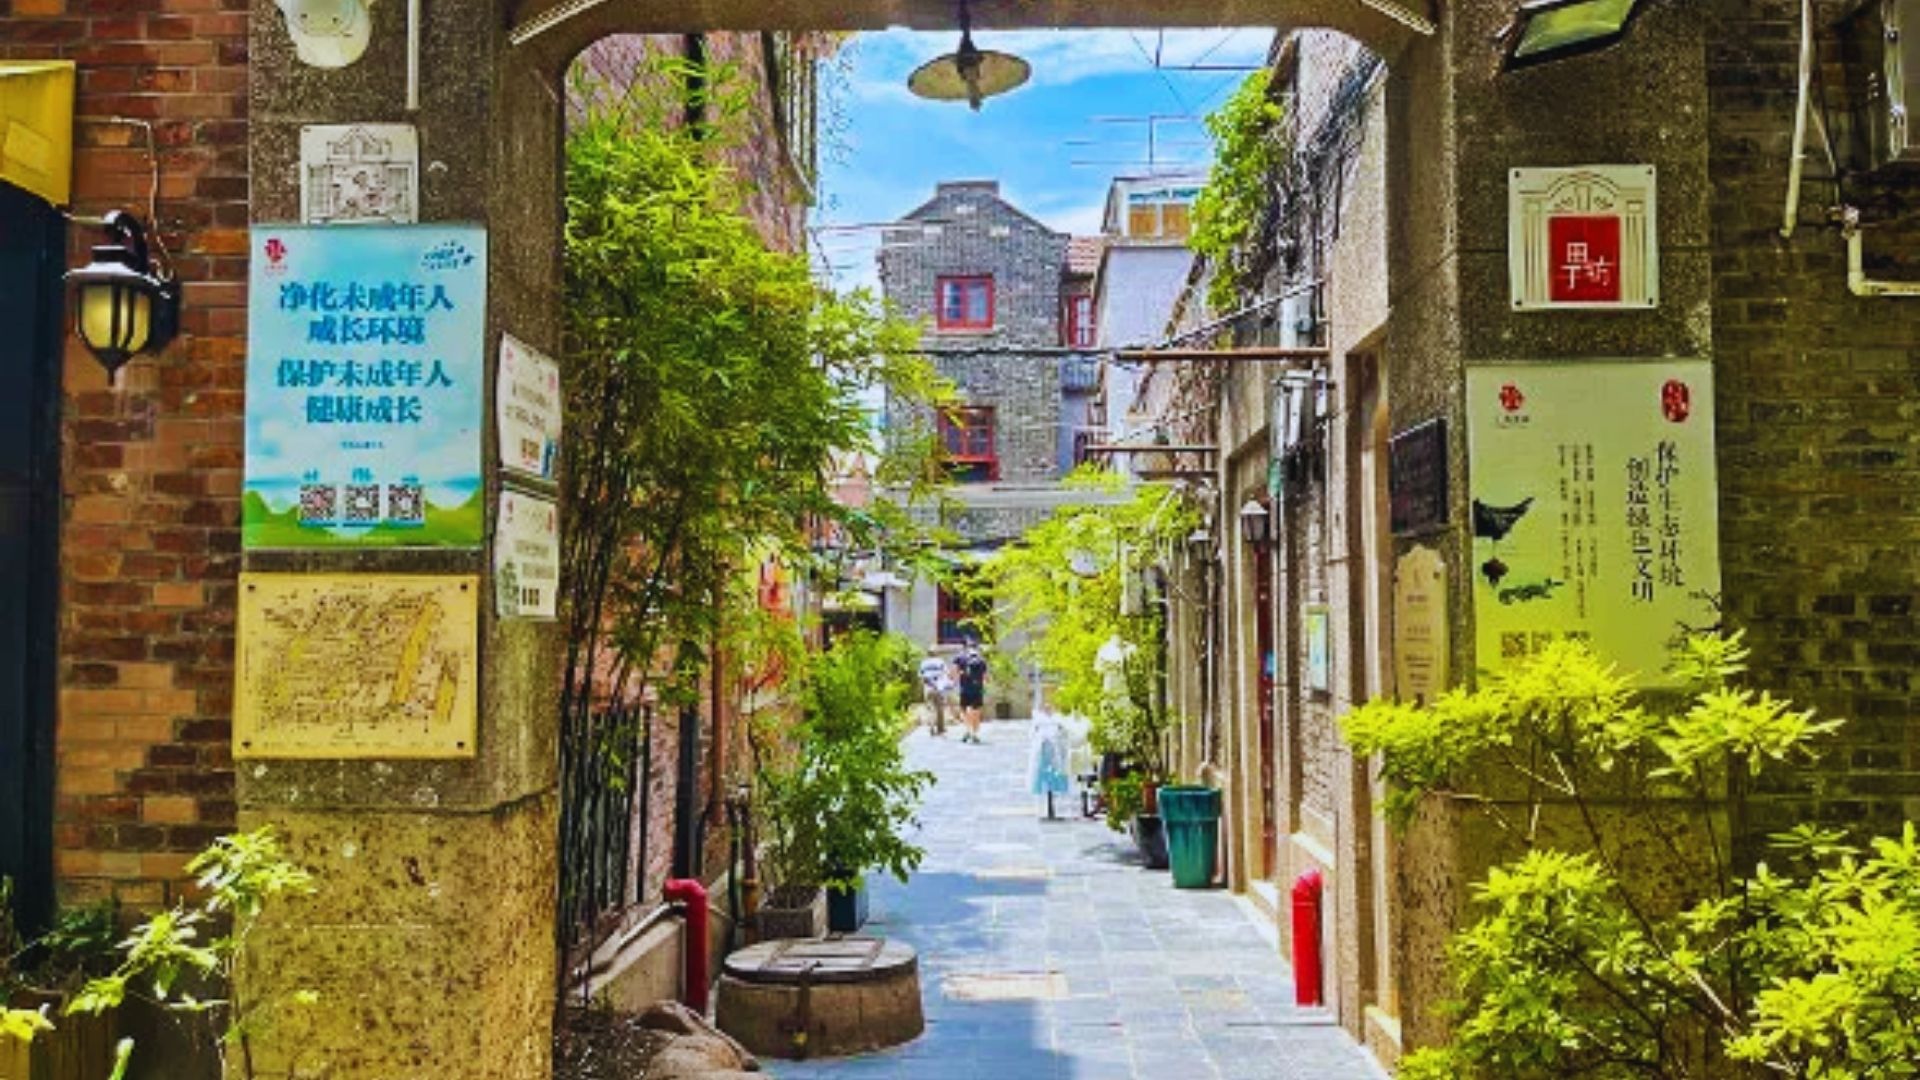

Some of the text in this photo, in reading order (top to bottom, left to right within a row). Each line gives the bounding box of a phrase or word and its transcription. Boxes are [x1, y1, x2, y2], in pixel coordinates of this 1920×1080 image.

[279, 280, 454, 310] 净化未成年人
[306, 315, 426, 346] 成长环境
[276, 359, 453, 388] 保护未成年人
[304, 395, 423, 424] 健康成长
[1655, 439, 1685, 588] 保护生态环境
[1625, 456, 1655, 604] 创造绿色文明
